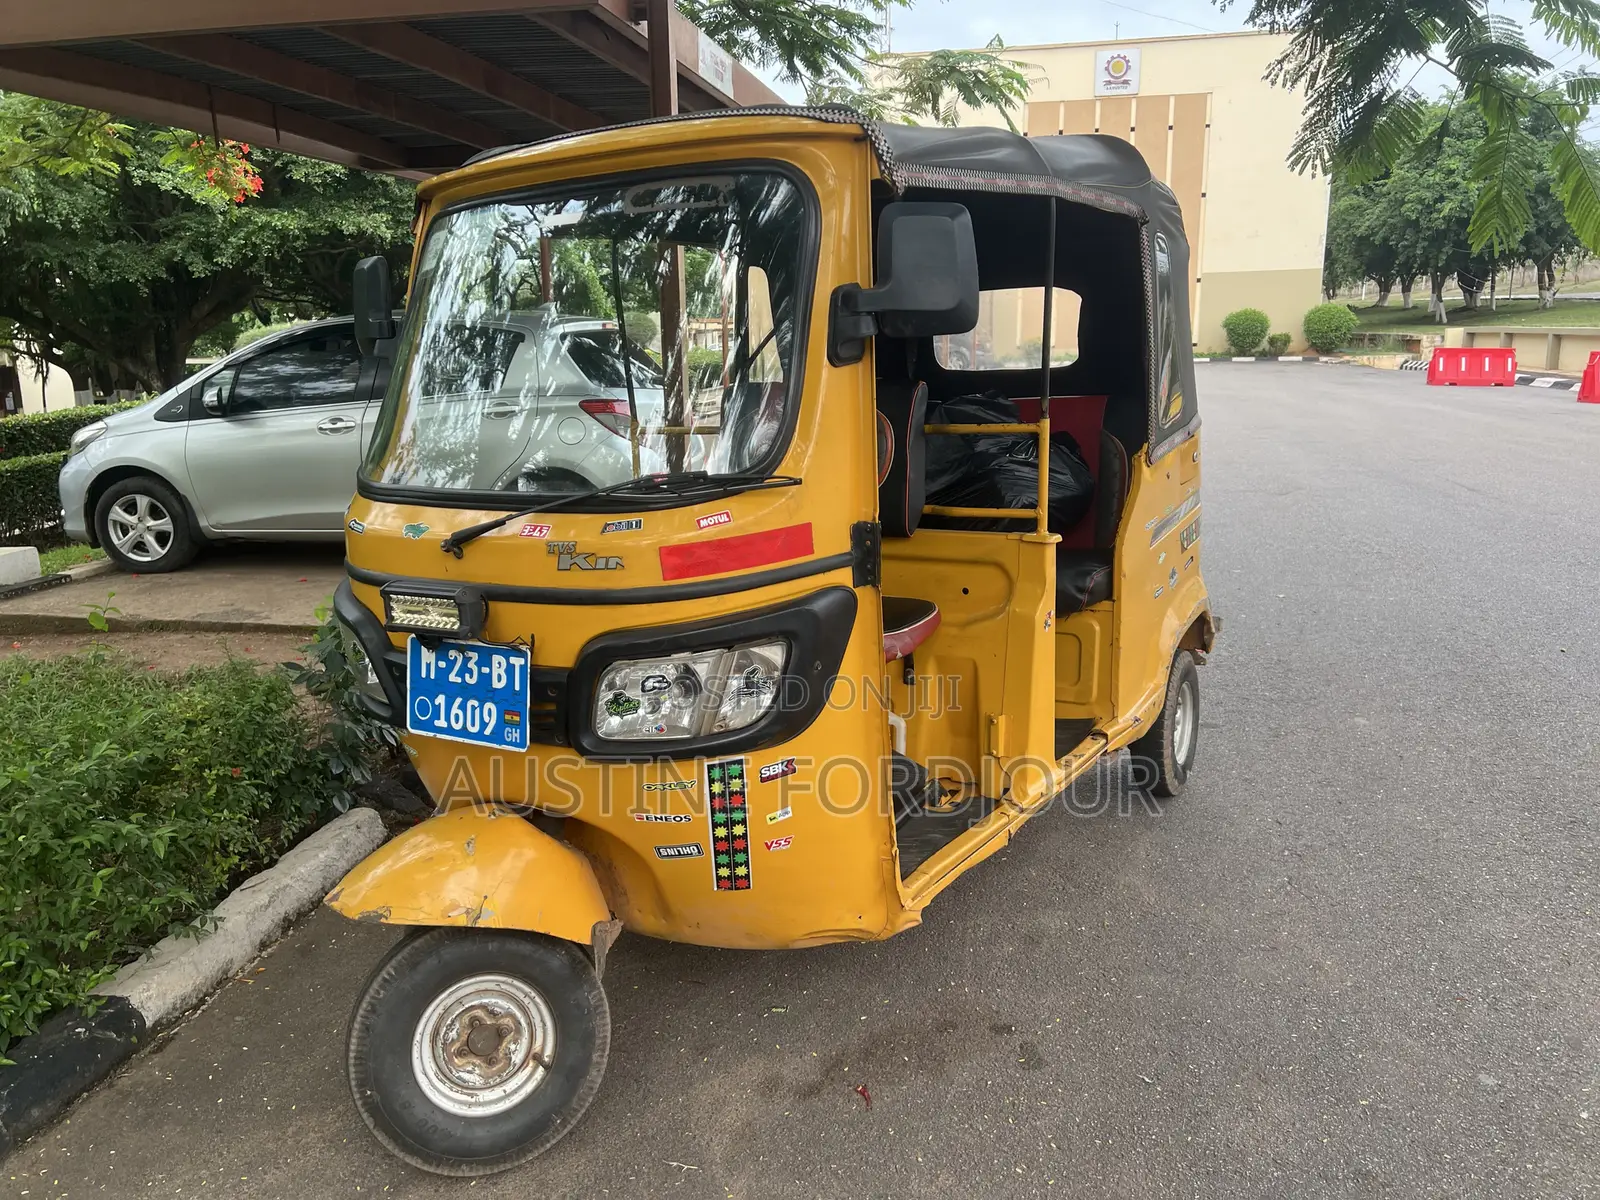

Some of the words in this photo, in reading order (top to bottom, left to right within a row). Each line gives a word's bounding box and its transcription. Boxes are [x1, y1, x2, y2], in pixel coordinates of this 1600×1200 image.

[699, 513, 729, 528] MOTUL
[521, 525, 549, 537] ヨシムラ
[547, 541, 577, 554] TVS
[421, 645, 525, 691] M-23-BT
[434, 694, 497, 736] 1609
[504, 727, 520, 743] GH
[761, 761, 789, 778] SBK
[643, 780, 696, 791] OAKLEY
[645, 814, 692, 823] ENEOS
